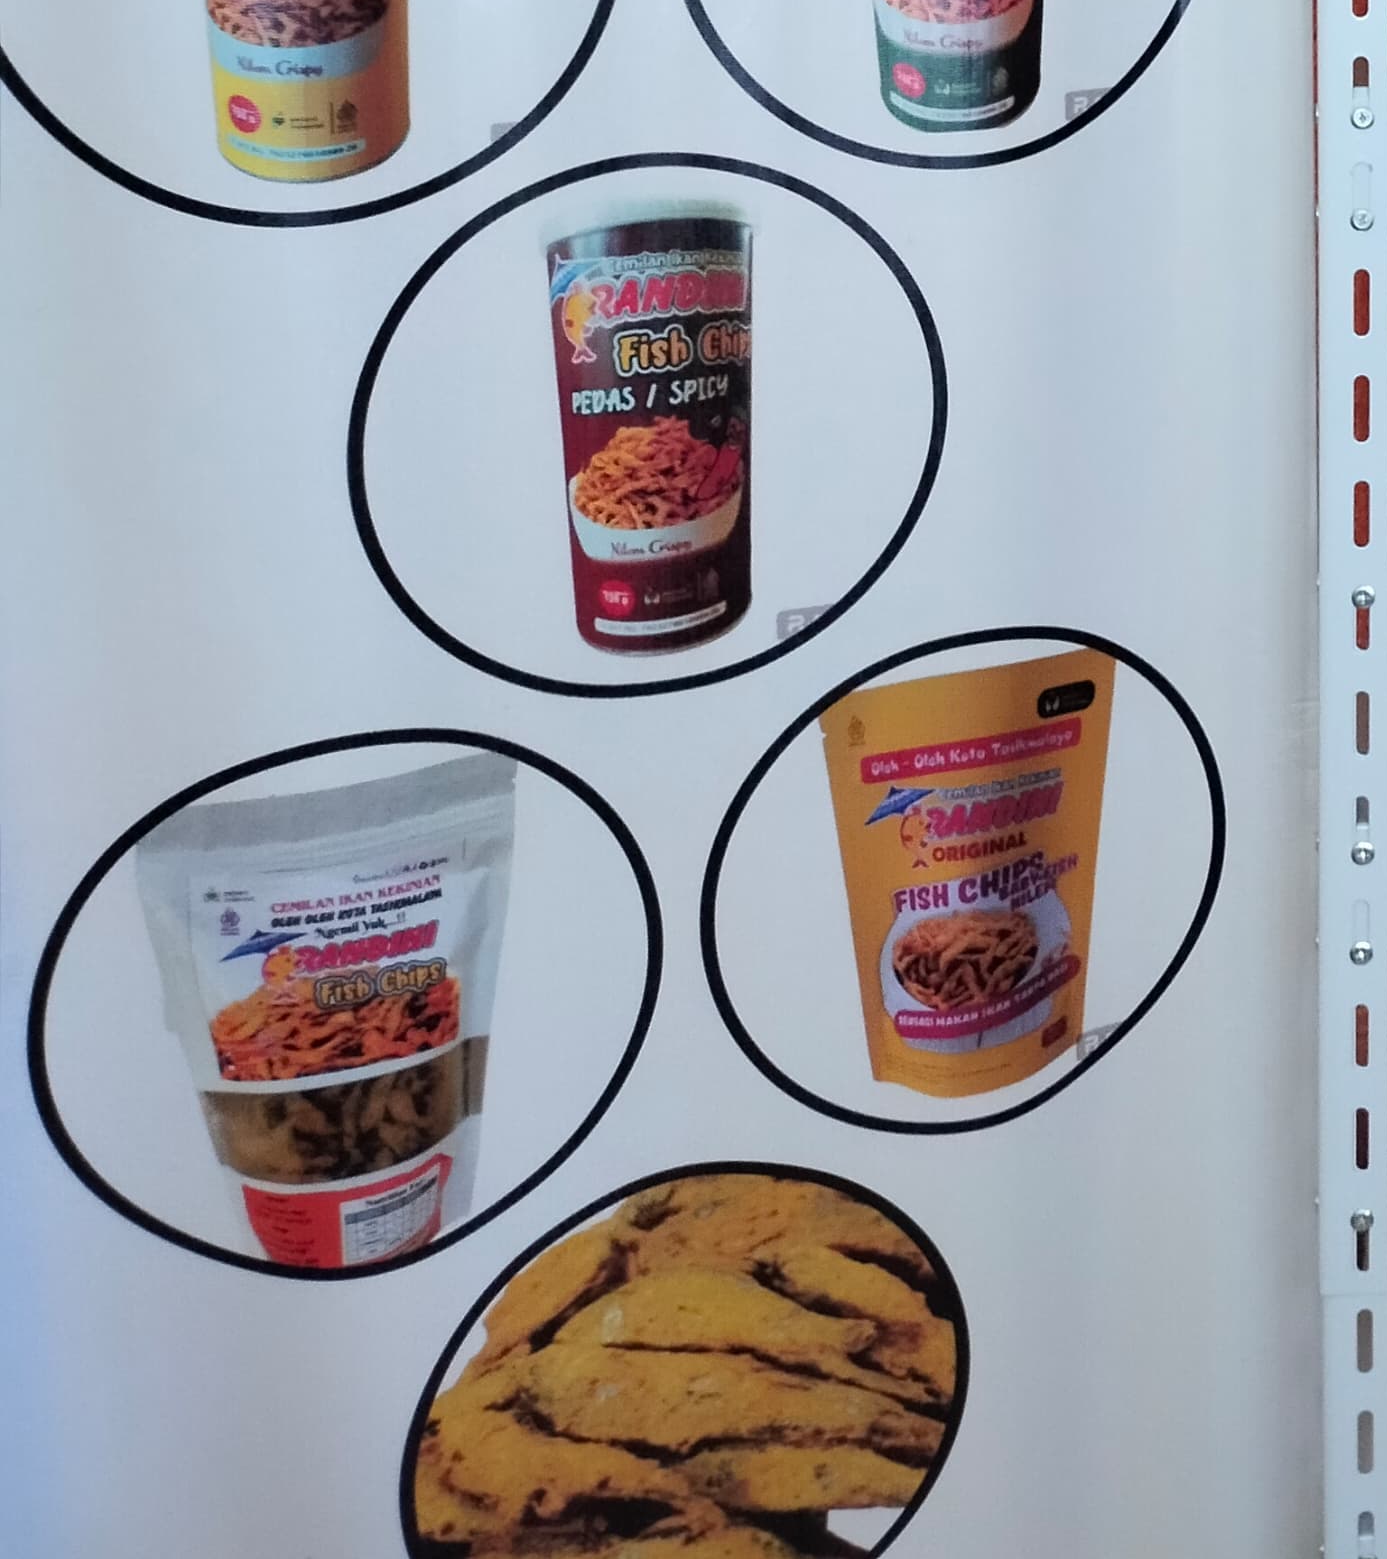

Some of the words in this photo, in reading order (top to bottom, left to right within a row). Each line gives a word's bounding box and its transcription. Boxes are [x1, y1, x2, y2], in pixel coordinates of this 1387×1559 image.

[615, 327, 690, 374] Fish
[572, 387, 635, 414] PEDAS
[670, 377, 728, 405] SPICY
[932, 831, 1026, 864] ORIGINAL
[271, 896, 334, 914] CEMILAN
[339, 890, 373, 906] IKAN
[377, 874, 441, 899] KEKINIAN
[893, 884, 949, 914] FISH
[958, 852, 1044, 904] CHIPS
[313, 975, 373, 1008] Fish
[377, 958, 447, 996] Chips
